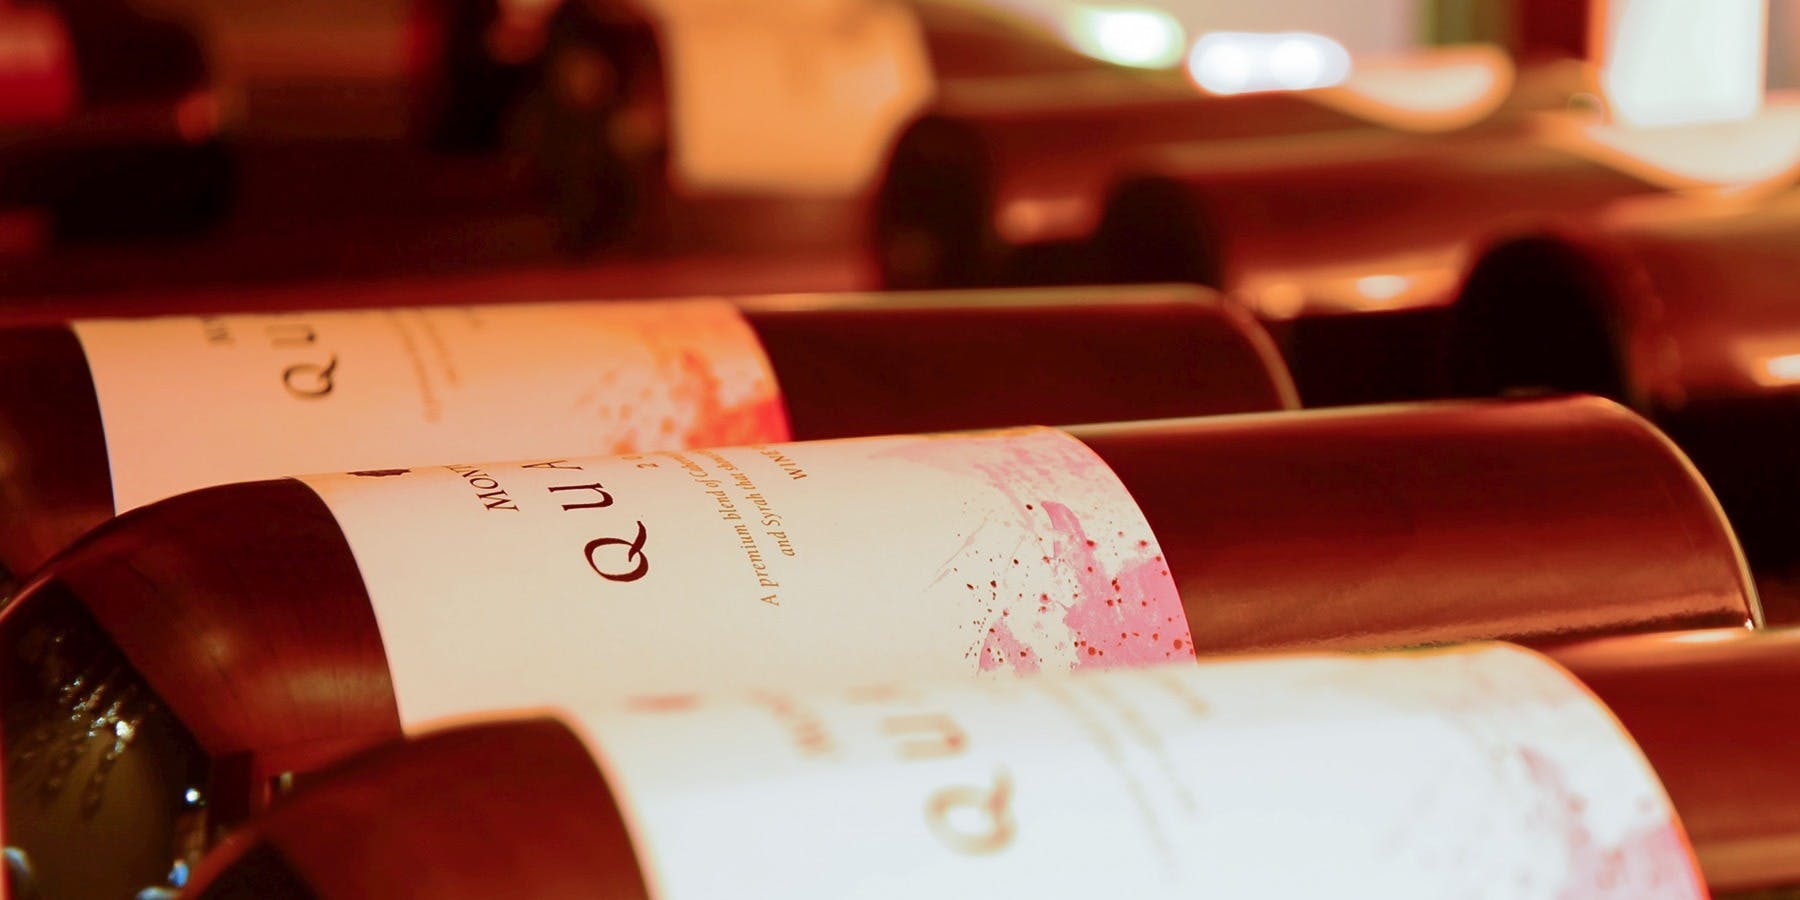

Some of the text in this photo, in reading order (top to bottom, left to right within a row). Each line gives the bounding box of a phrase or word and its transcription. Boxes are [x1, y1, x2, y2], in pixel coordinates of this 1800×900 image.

[694, 479, 722, 488] of
[730, 472, 756, 490] that
[705, 488, 742, 521] blend
[744, 493, 783, 528] Syrah
[734, 523, 780, 588] premium
[766, 530, 797, 558] and
[760, 593, 780, 607] A
